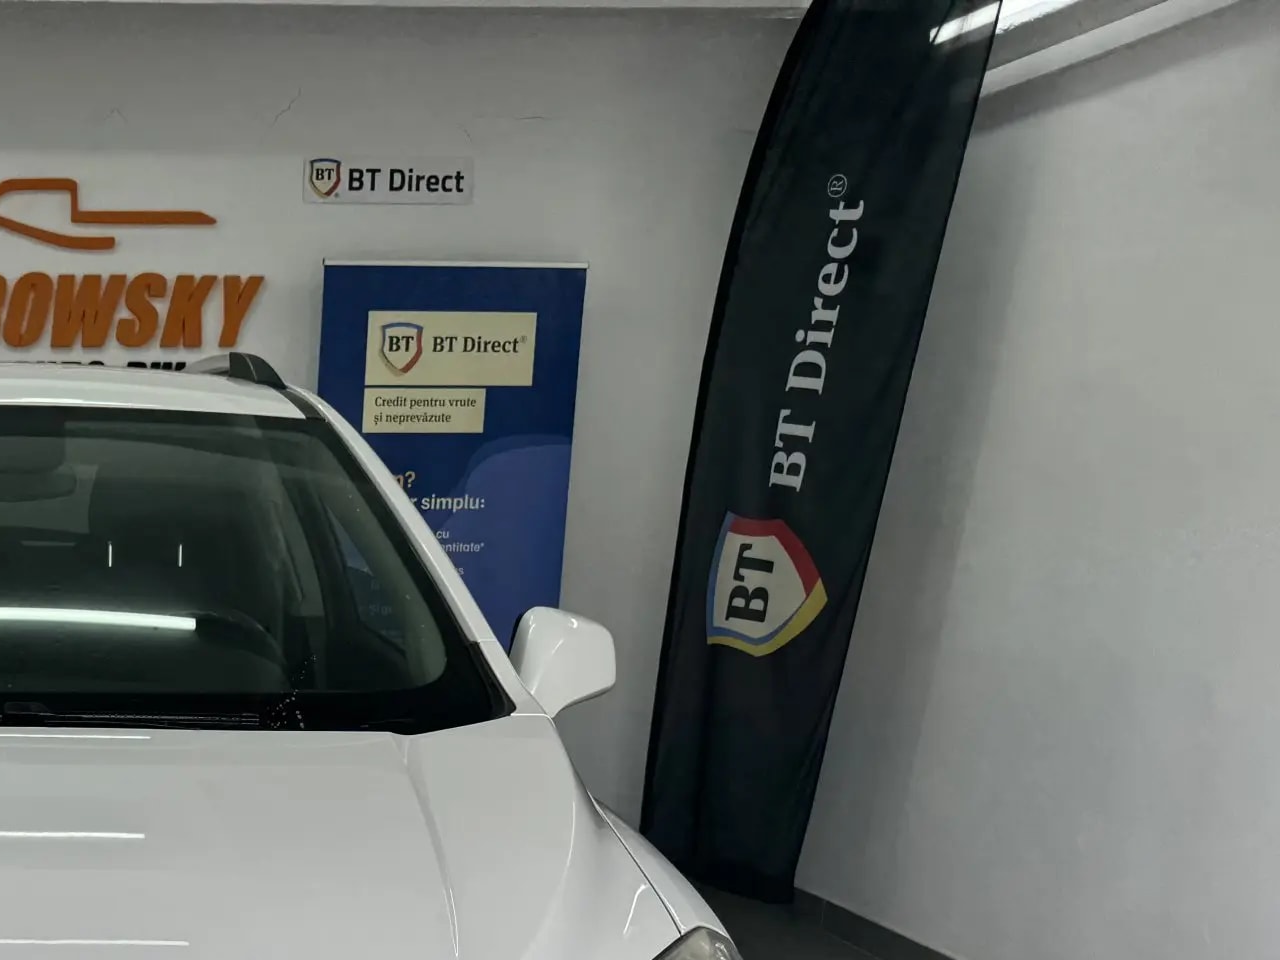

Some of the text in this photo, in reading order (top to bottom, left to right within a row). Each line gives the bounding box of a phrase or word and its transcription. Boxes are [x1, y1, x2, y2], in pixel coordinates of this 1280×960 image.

[315, 168, 335, 181] BT
[348, 168, 465, 193] BT Direct
[388, 335, 415, 353] BT
[432, 336, 458, 353] BT
[374, 396, 477, 410] Credit pentru vrute
[769, 408, 817, 493] BT
[421, 494, 485, 513] simplu:
[435, 531, 450, 540] cu
[725, 543, 775, 623] BT
